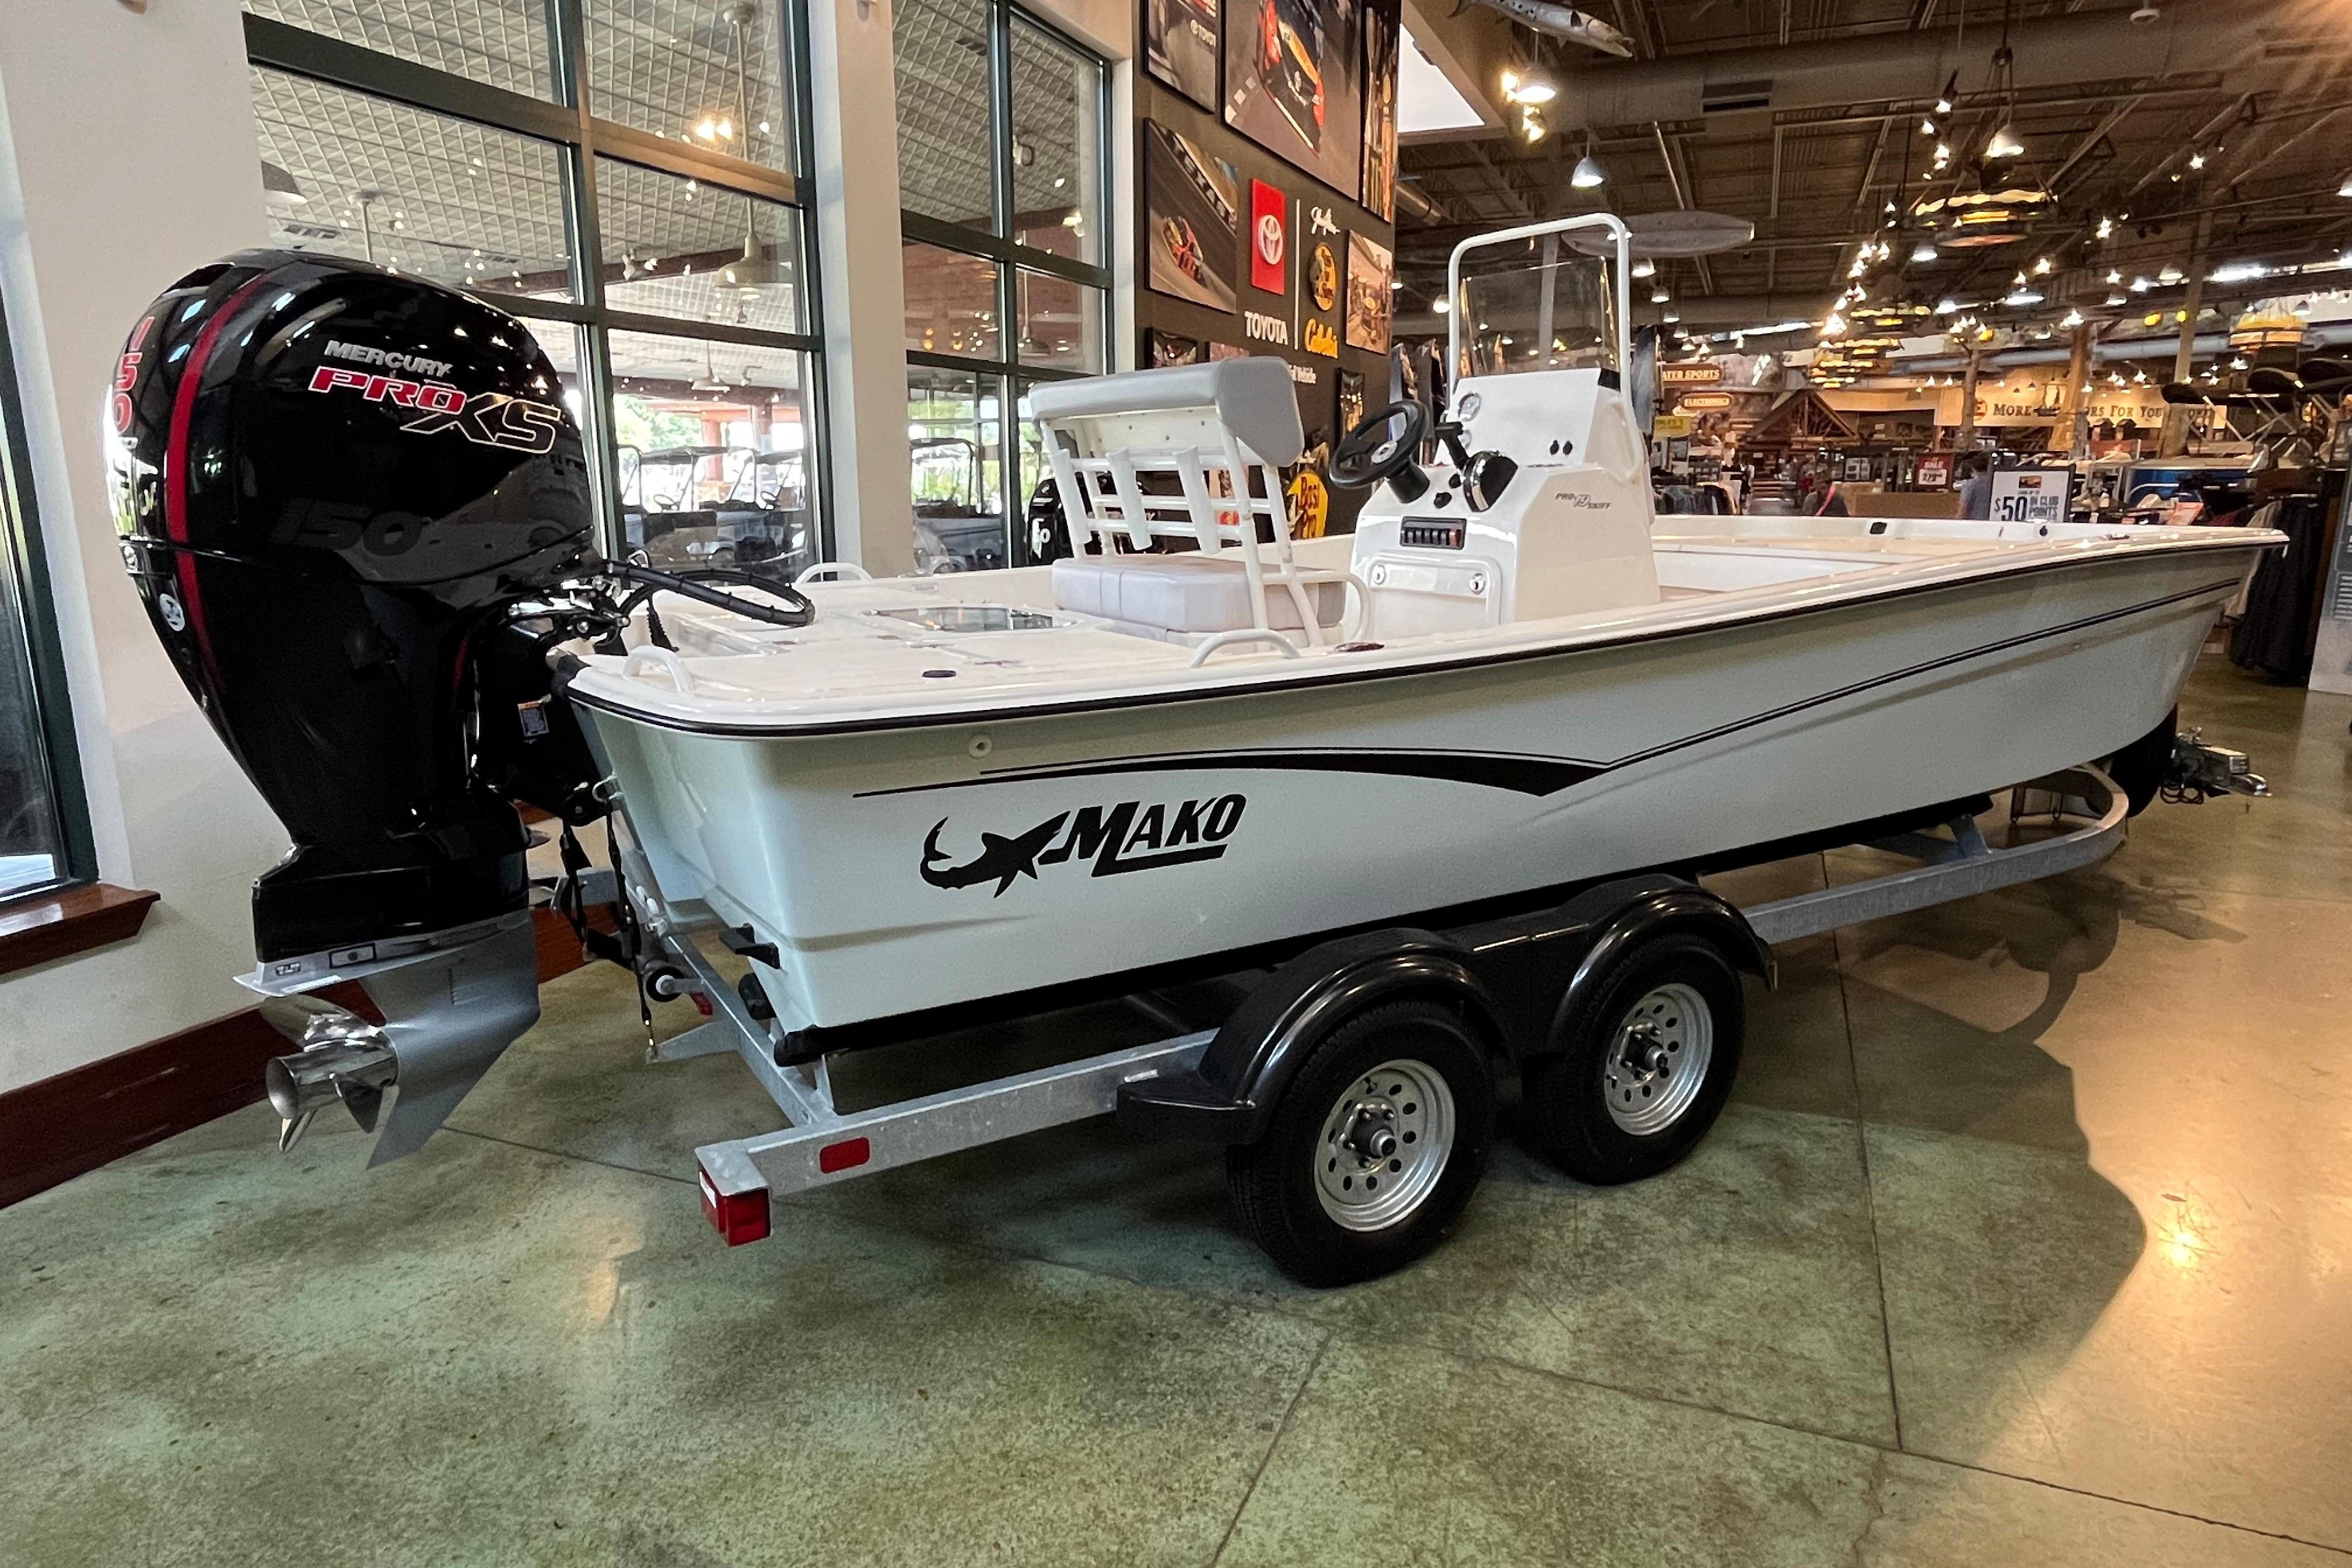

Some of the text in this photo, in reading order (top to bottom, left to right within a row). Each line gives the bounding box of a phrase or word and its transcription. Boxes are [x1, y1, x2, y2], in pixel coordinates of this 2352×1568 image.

[1244, 310, 1288, 345] TOYOTA
[324, 340, 453, 378] MERCURY
[1662, 369, 1720, 380] ATER SPORTS
[308, 366, 561, 454] PRO XS
[1993, 403, 2032, 416] MORE
[2110, 405, 2133, 418] FOR
[2140, 406, 2163, 418] YOU
[1994, 496, 2028, 521] $50
[1038, 793, 1247, 877] MAKO
